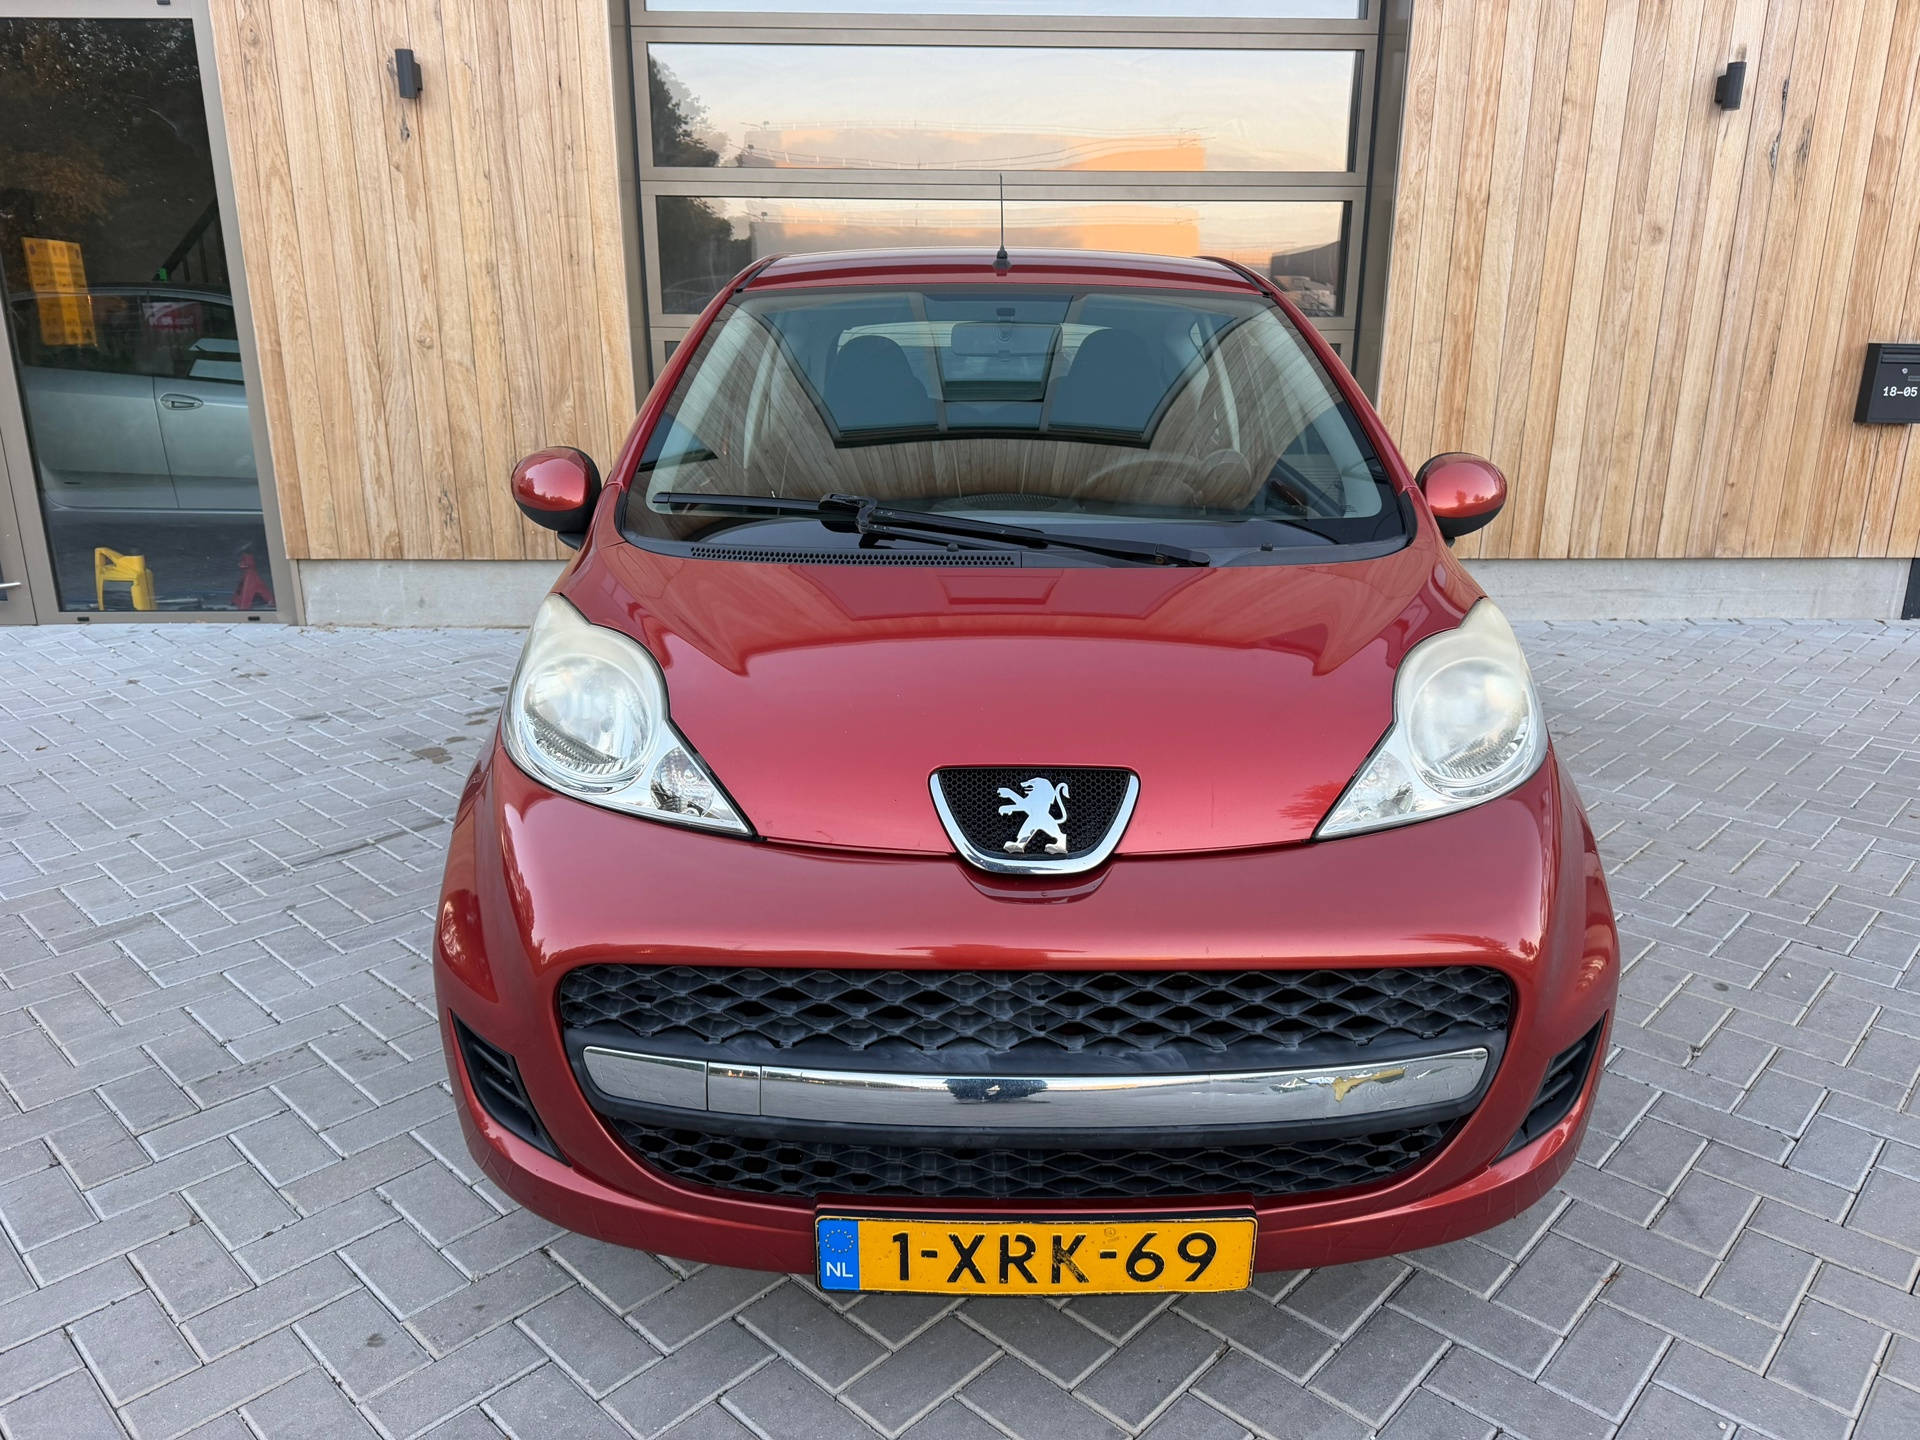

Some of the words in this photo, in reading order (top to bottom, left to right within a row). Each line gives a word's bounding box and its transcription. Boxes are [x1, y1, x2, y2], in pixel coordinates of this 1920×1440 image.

[1883, 386, 1918, 397] 18-05
[892, 1232, 1217, 1284] 1-XRK-69
[826, 1262, 853, 1278] NL
